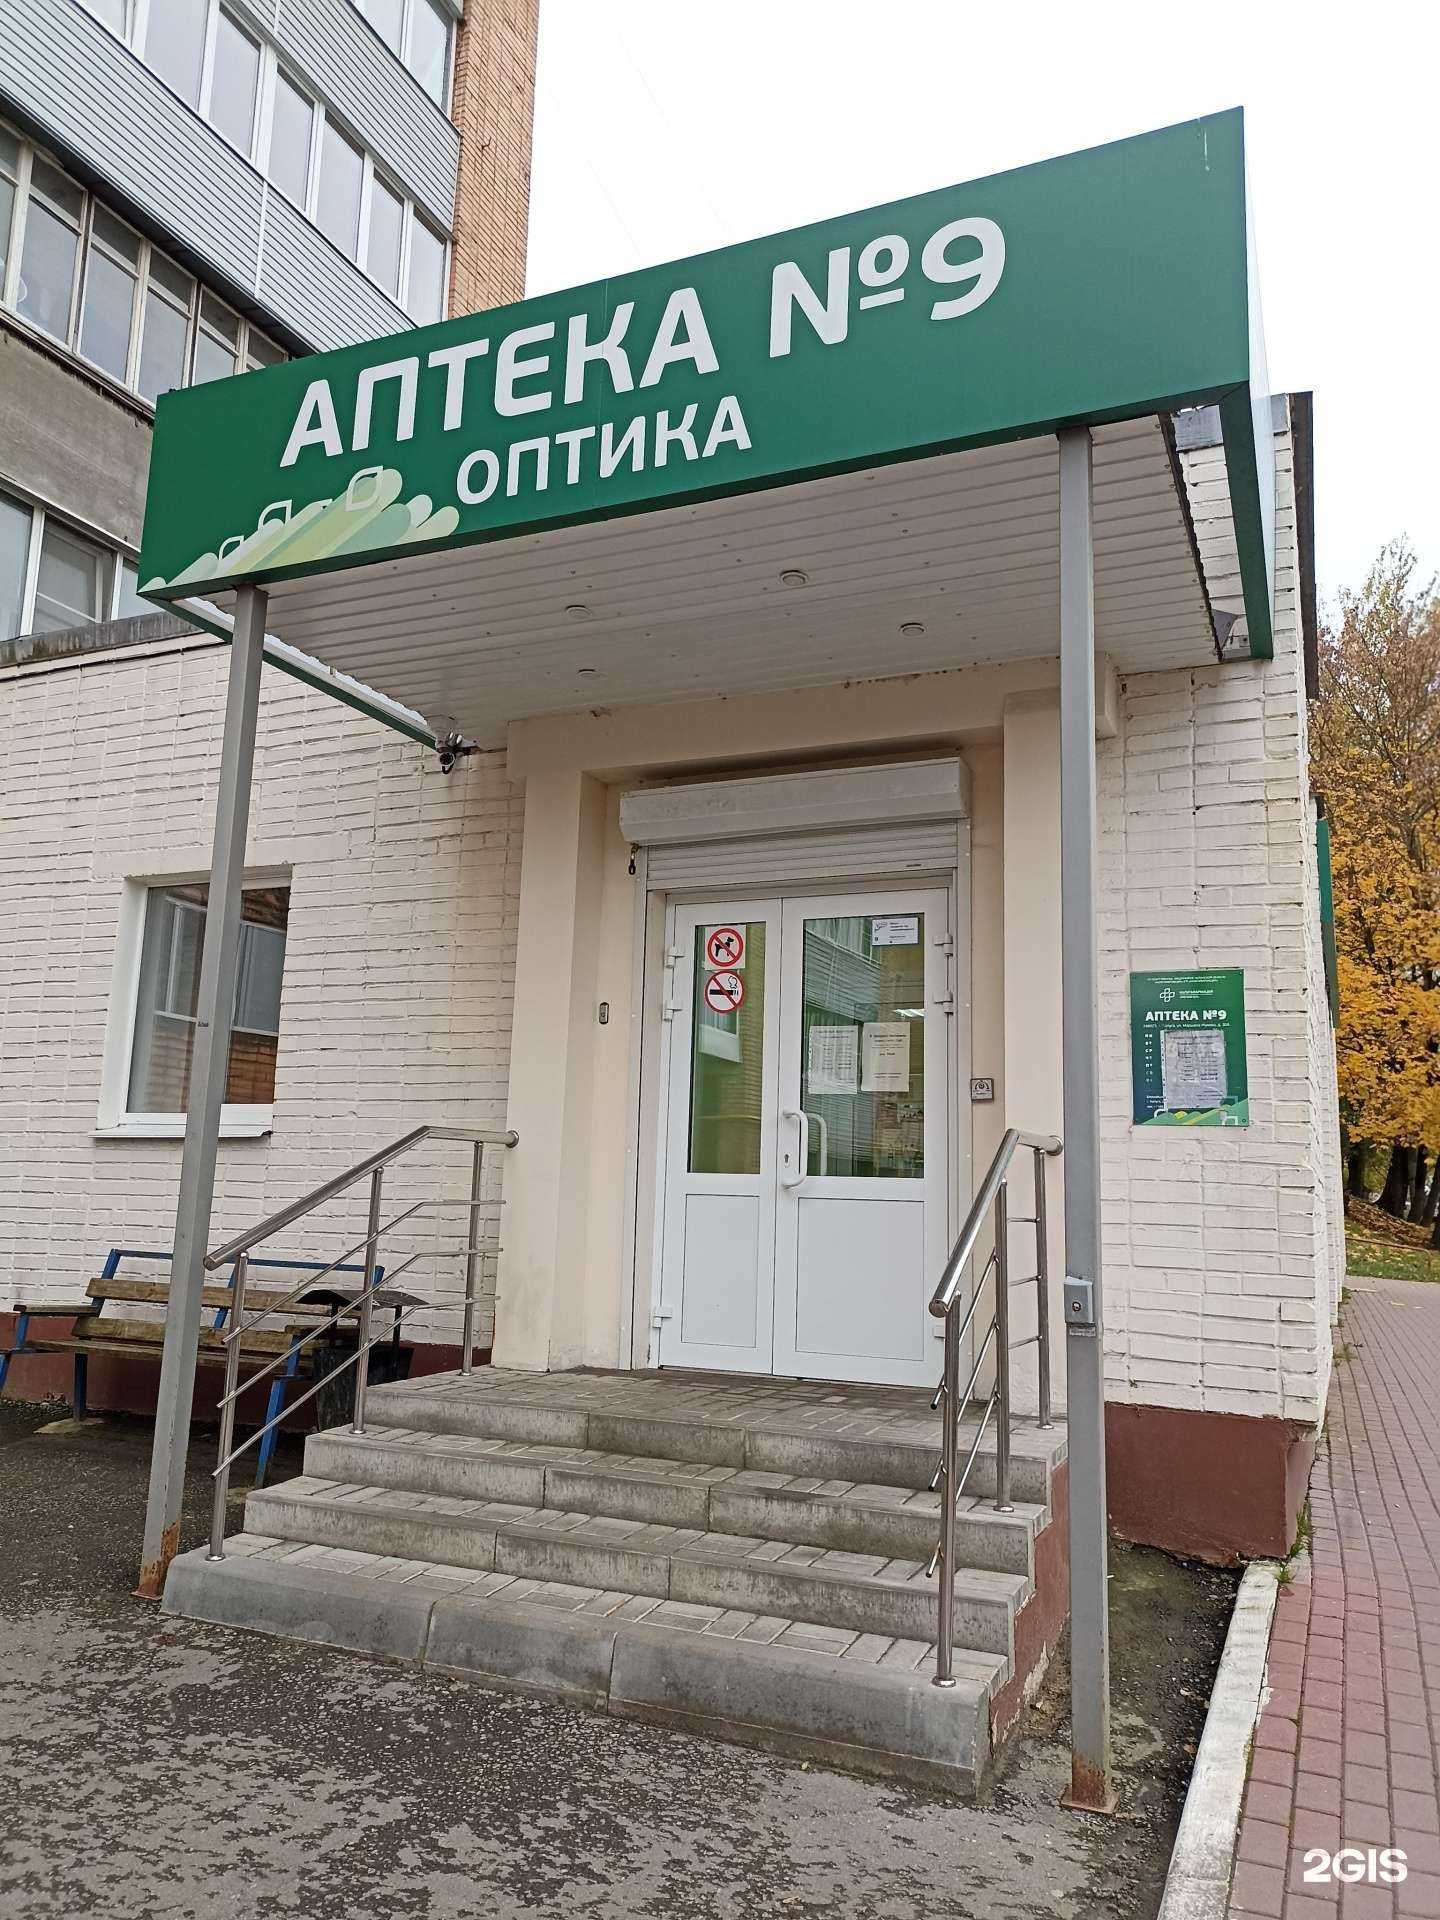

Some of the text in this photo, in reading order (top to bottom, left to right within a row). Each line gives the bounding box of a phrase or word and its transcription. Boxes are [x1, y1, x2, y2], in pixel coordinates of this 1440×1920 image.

[280, 216, 1006, 468] АПТЕКА №9
[456, 395, 752, 505] ОПТИКА
[1145, 1009, 1227, 1022] АПТЕКА №9
